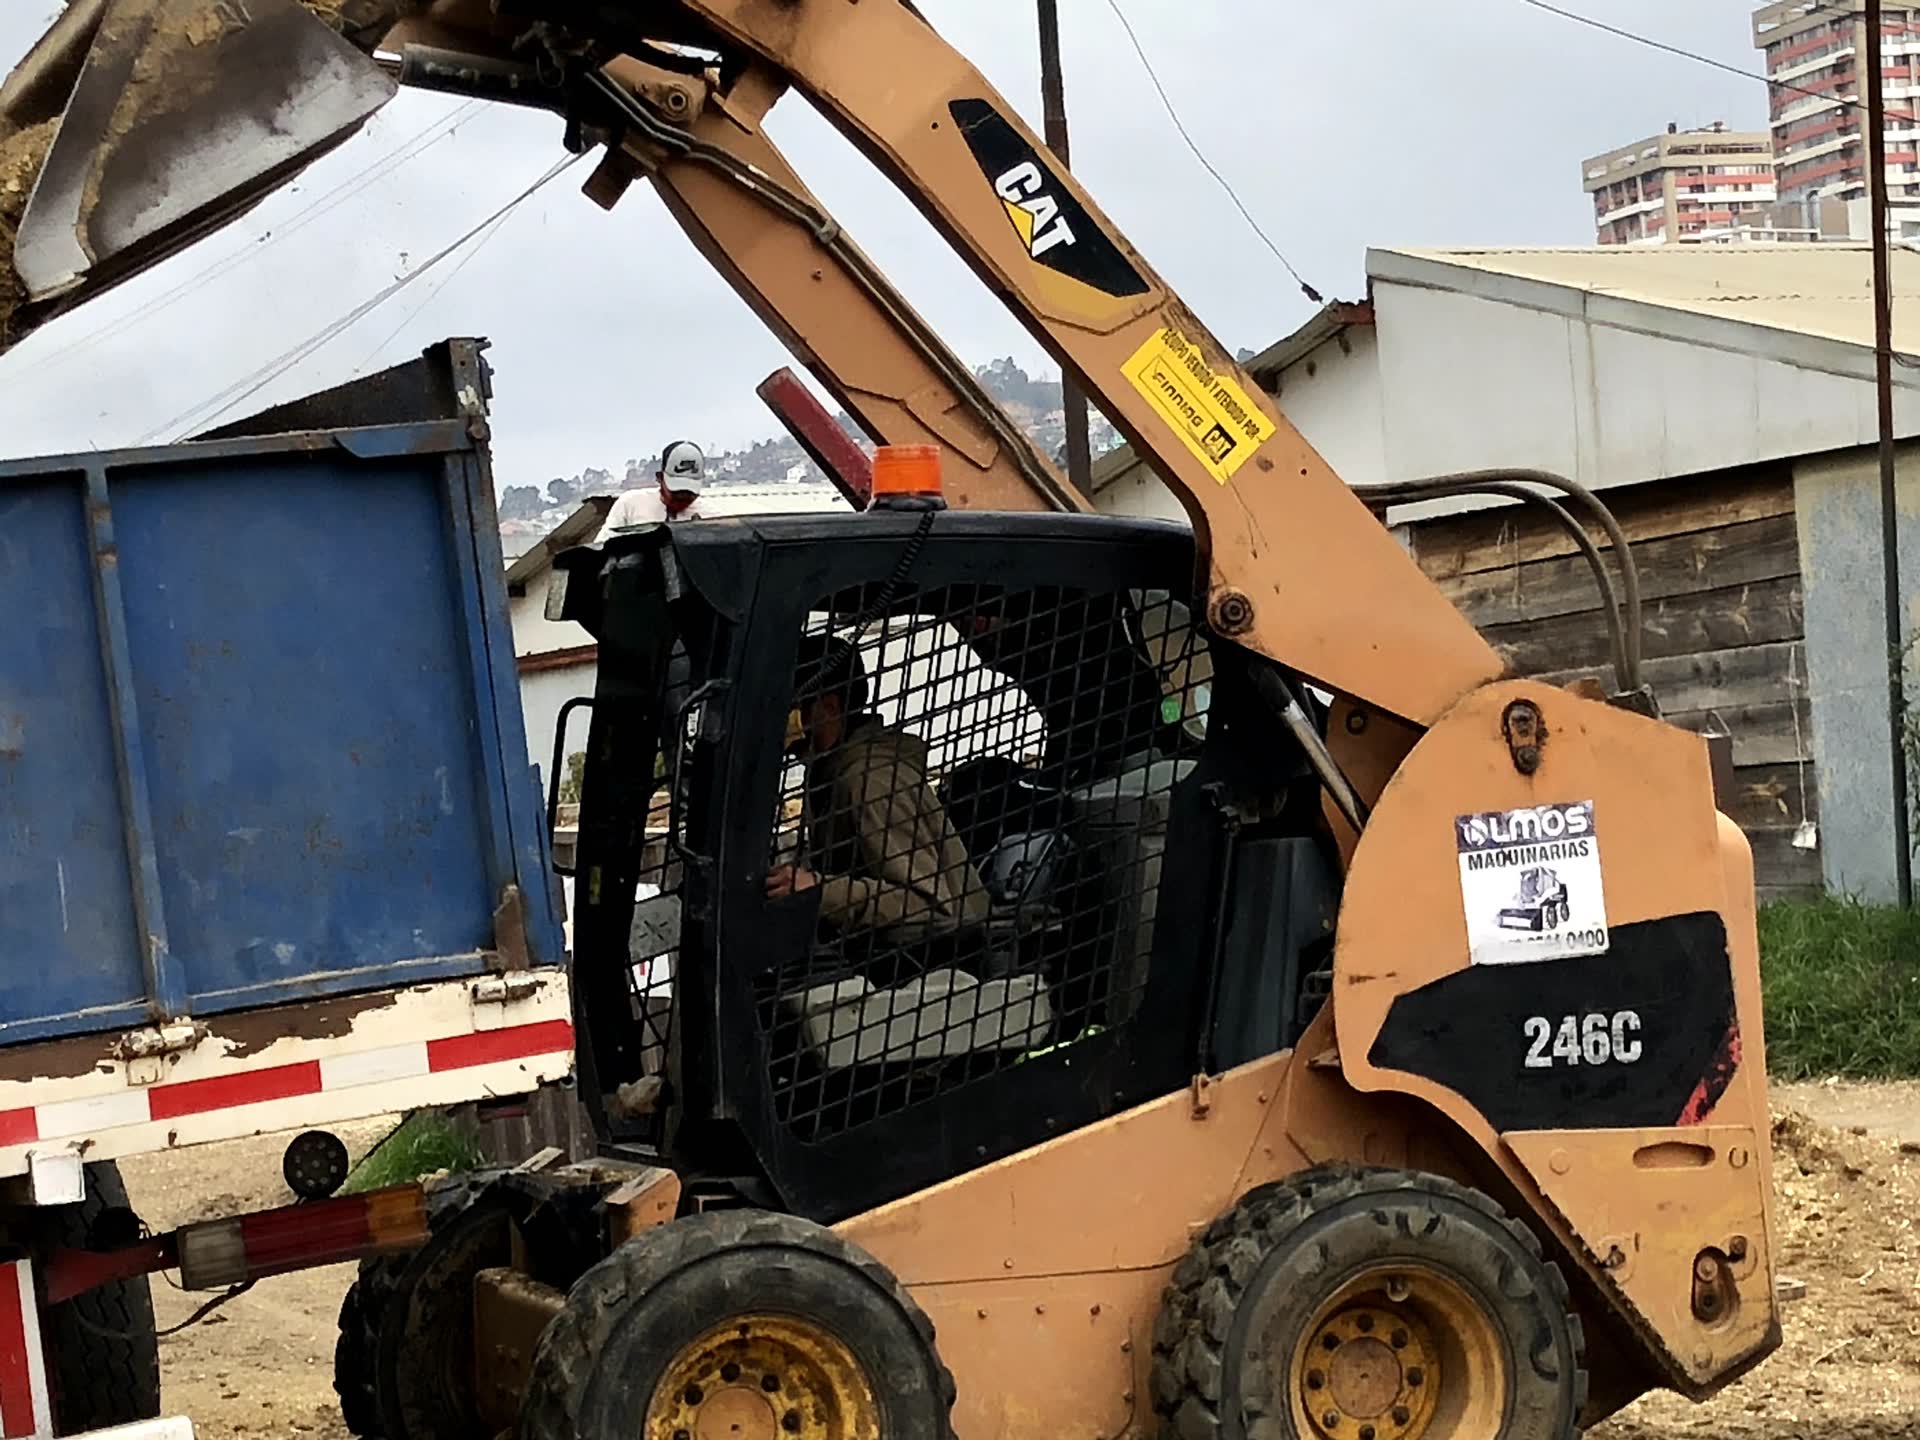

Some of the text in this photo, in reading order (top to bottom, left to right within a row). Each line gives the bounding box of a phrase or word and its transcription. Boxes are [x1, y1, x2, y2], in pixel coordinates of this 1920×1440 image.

[995, 161, 1077, 257] CAT
[1184, 353, 1214, 388] VENDIDO
[1208, 379, 1221, 394] Y
[1213, 388, 1246, 426] ATENDIDO
[1203, 429, 1232, 463] CAT
[1240, 419, 1260, 440] POR
[1468, 840, 1589, 871] MAQUINARIAS
[1524, 1010, 1642, 1068] 246C
